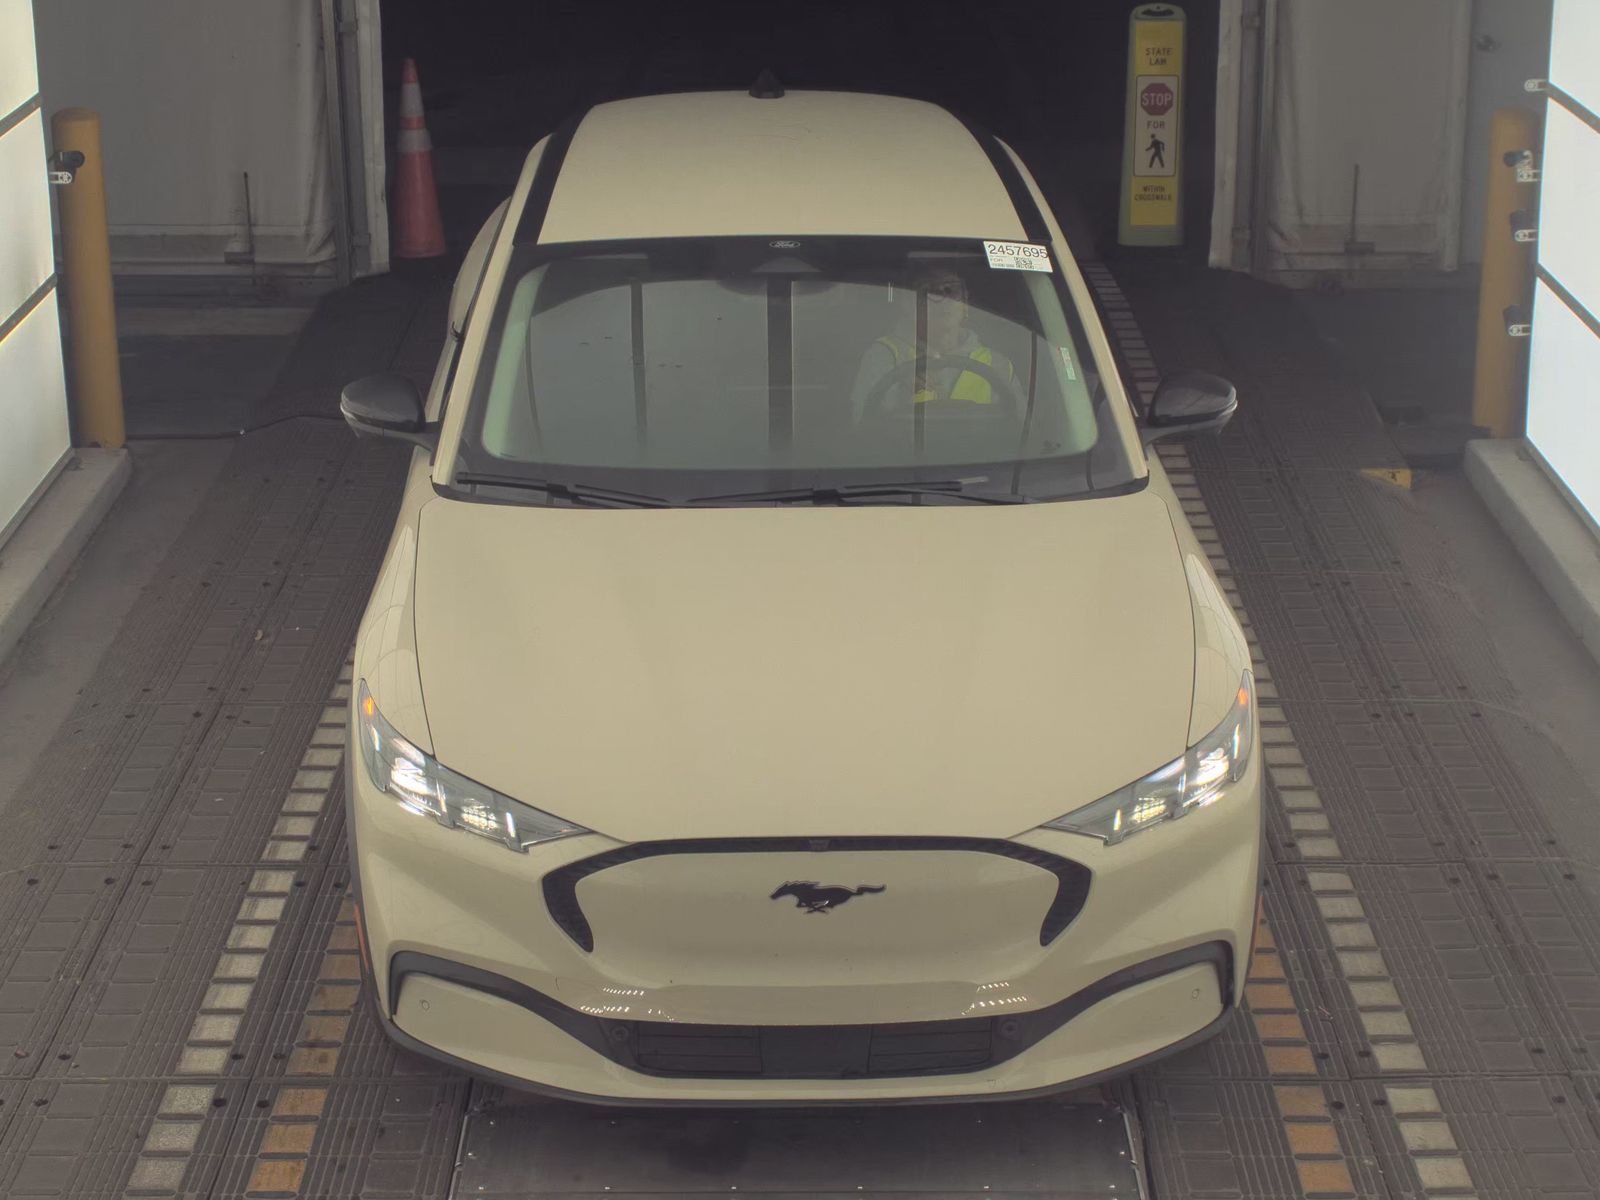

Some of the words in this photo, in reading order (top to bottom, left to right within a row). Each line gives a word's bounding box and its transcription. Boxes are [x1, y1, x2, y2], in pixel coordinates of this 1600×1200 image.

[1145, 48, 1173, 56] STATE
[1142, 93, 1172, 106] STOP
[1146, 121, 1165, 129] FOR
[988, 244, 1048, 258] 2457695
